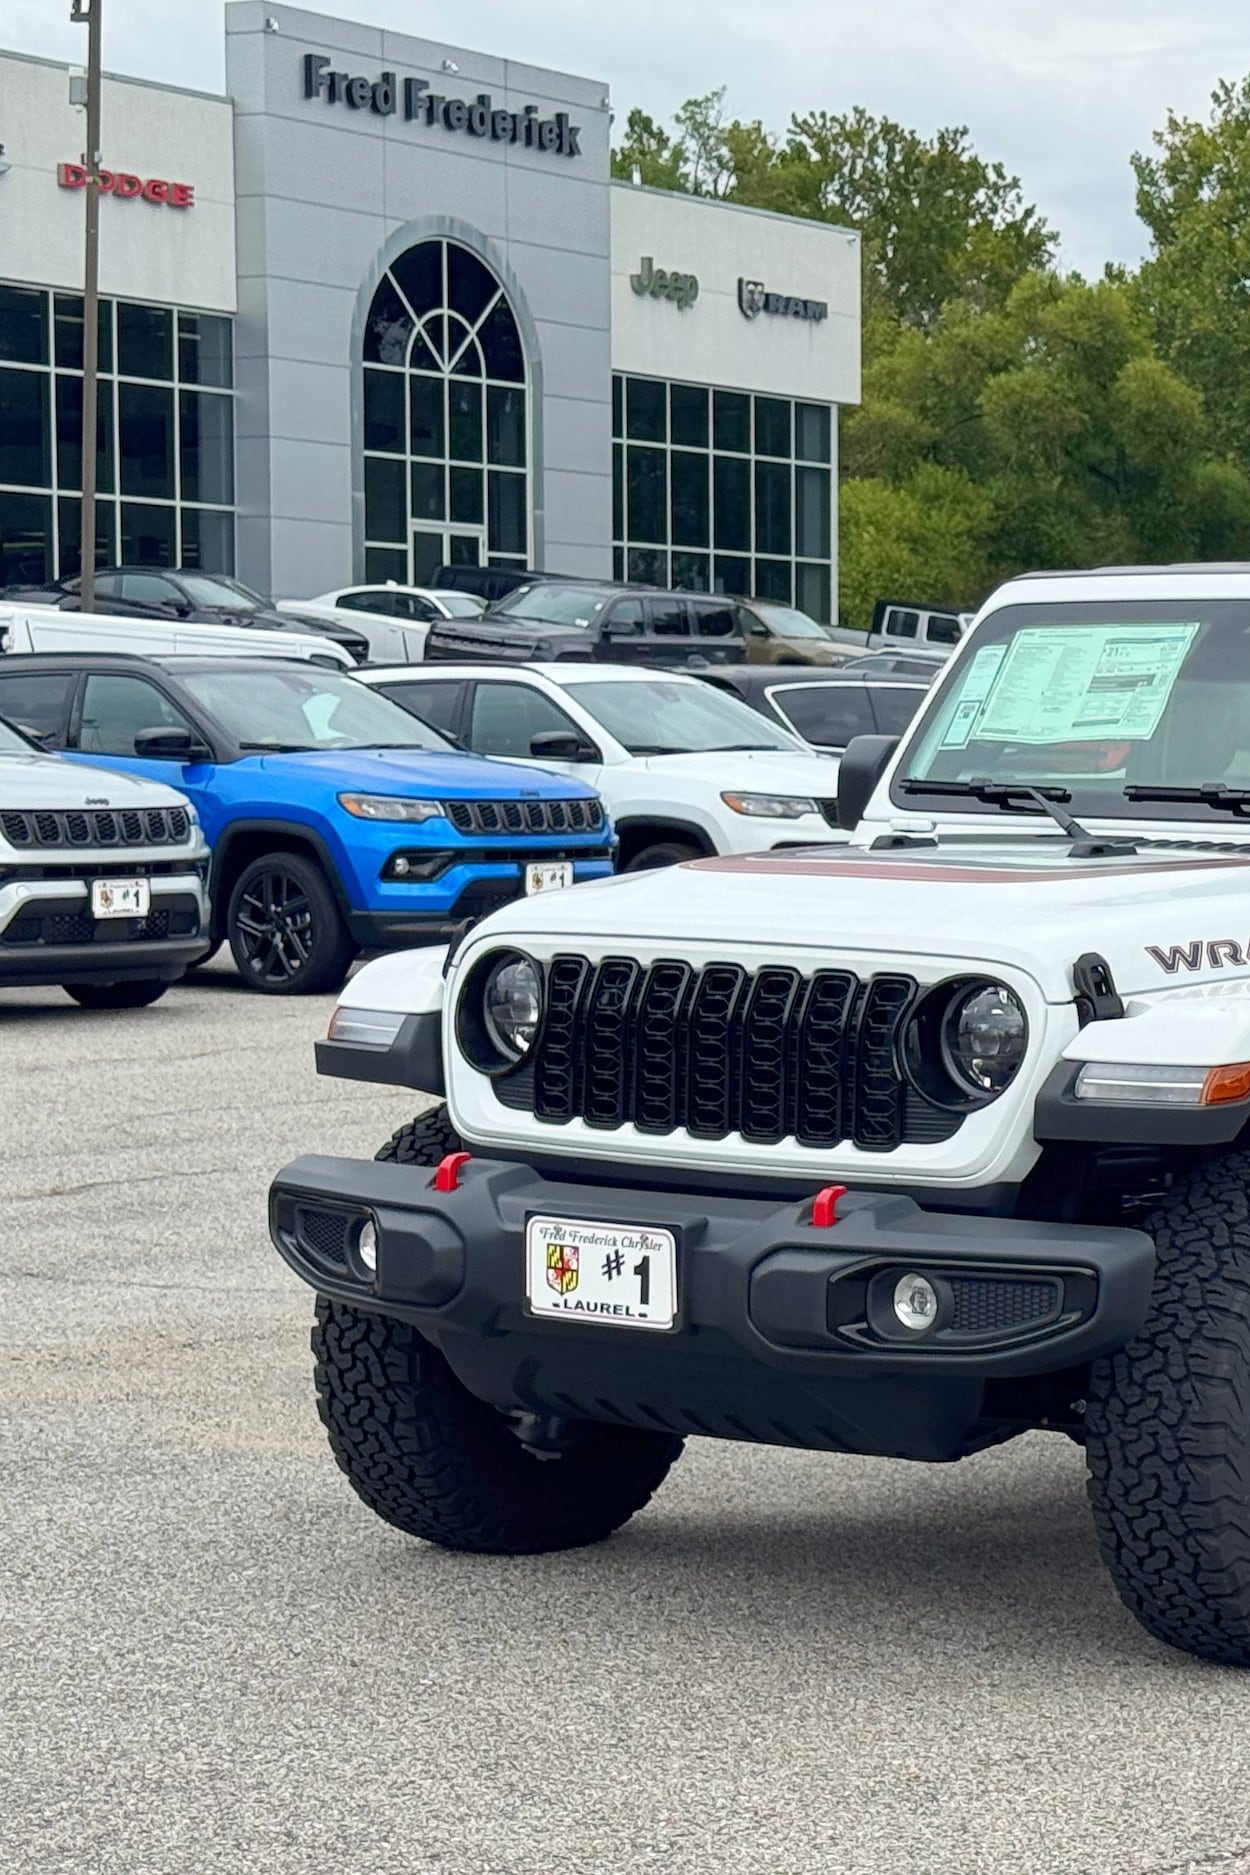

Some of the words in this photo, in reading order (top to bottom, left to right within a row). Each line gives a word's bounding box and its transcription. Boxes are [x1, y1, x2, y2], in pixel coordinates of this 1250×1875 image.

[304, 54, 397, 116] Fred
[404, 77, 582, 157] Frederick
[57, 162, 195, 209] DODGE
[630, 256, 699, 312] Jeep
[763, 292, 829, 322] RAM
[539, 1226, 567, 1241] Fred
[568, 1230, 618, 1247] Frederick
[621, 1235, 664, 1252] Chrysler
